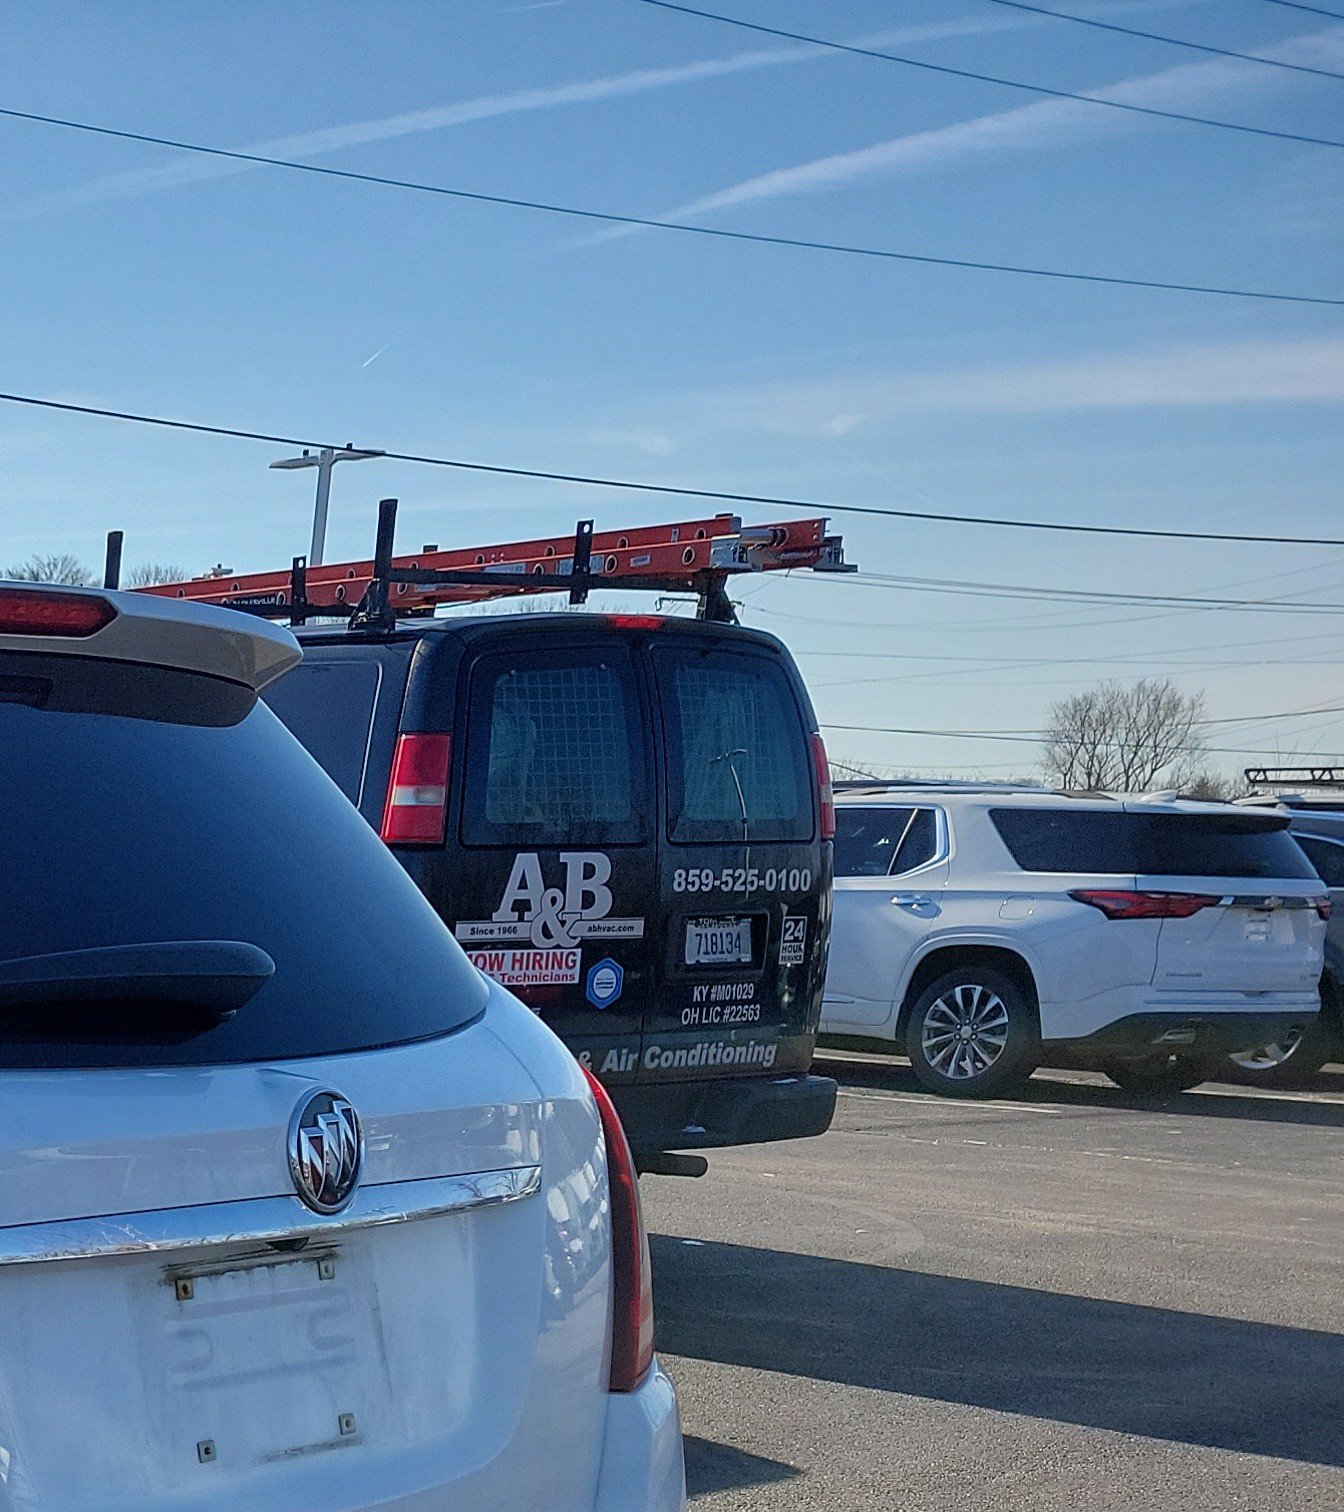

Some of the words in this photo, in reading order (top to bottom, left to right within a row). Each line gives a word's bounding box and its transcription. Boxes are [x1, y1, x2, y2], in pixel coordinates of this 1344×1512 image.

[673, 868, 811, 892] 859-525-0100
[492, 852, 613, 949] A&B
[470, 927, 495, 936] Since
[587, 924, 635, 935] abhvac.com
[784, 920, 804, 941] 24
[511, 951, 577, 971] HIRING
[499, 972, 576, 984] Technicians
[693, 985, 709, 1002] KY
[710, 982, 754, 1001] #M01029
[681, 1007, 700, 1025] OH
[702, 1006, 722, 1024] LIC
[722, 1003, 761, 1023] #22563
[601, 1049, 642, 1073] Air
[644, 1041, 777, 1071] Conditioning
